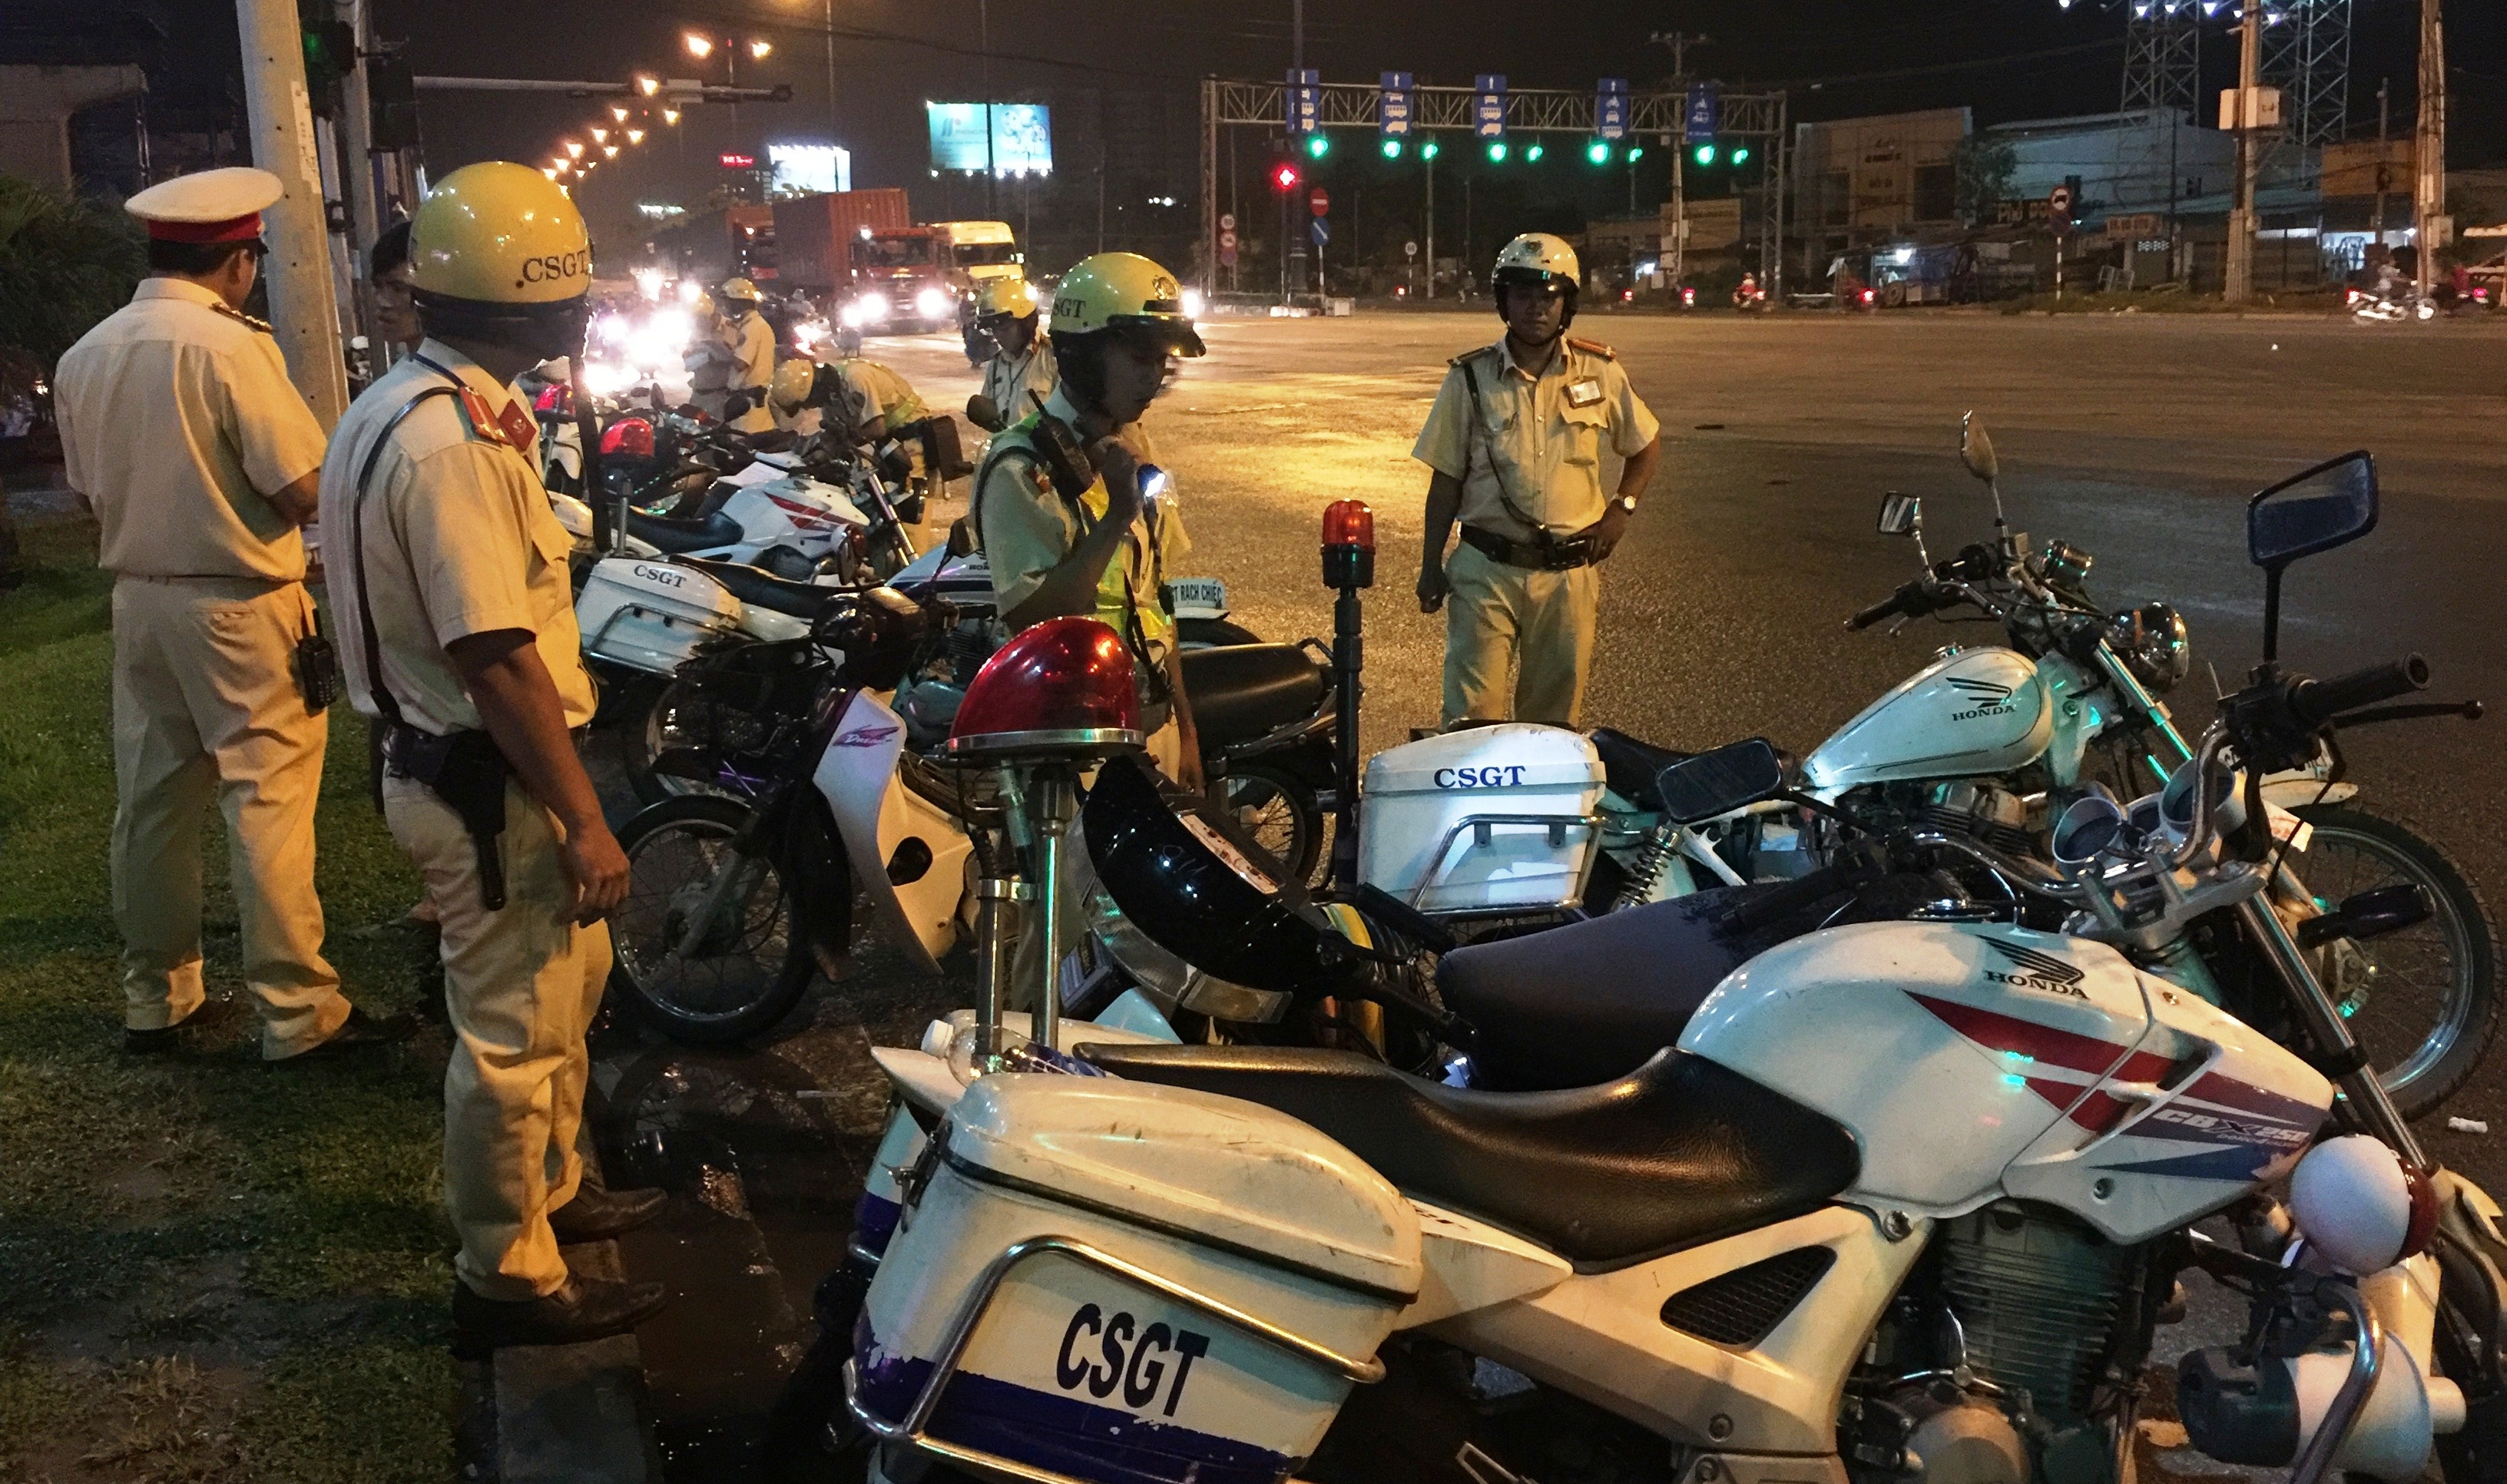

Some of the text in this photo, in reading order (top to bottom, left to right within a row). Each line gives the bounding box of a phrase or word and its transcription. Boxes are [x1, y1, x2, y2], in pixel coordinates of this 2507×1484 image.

[522, 250, 588, 283] CSGT
[634, 565, 687, 588] CSGT
[1952, 705, 2015, 721] HONDA
[1433, 765, 1526, 789] CSGT
[1984, 969, 2091, 1000] HONDA
[1056, 1303, 1210, 1417] CSGT
